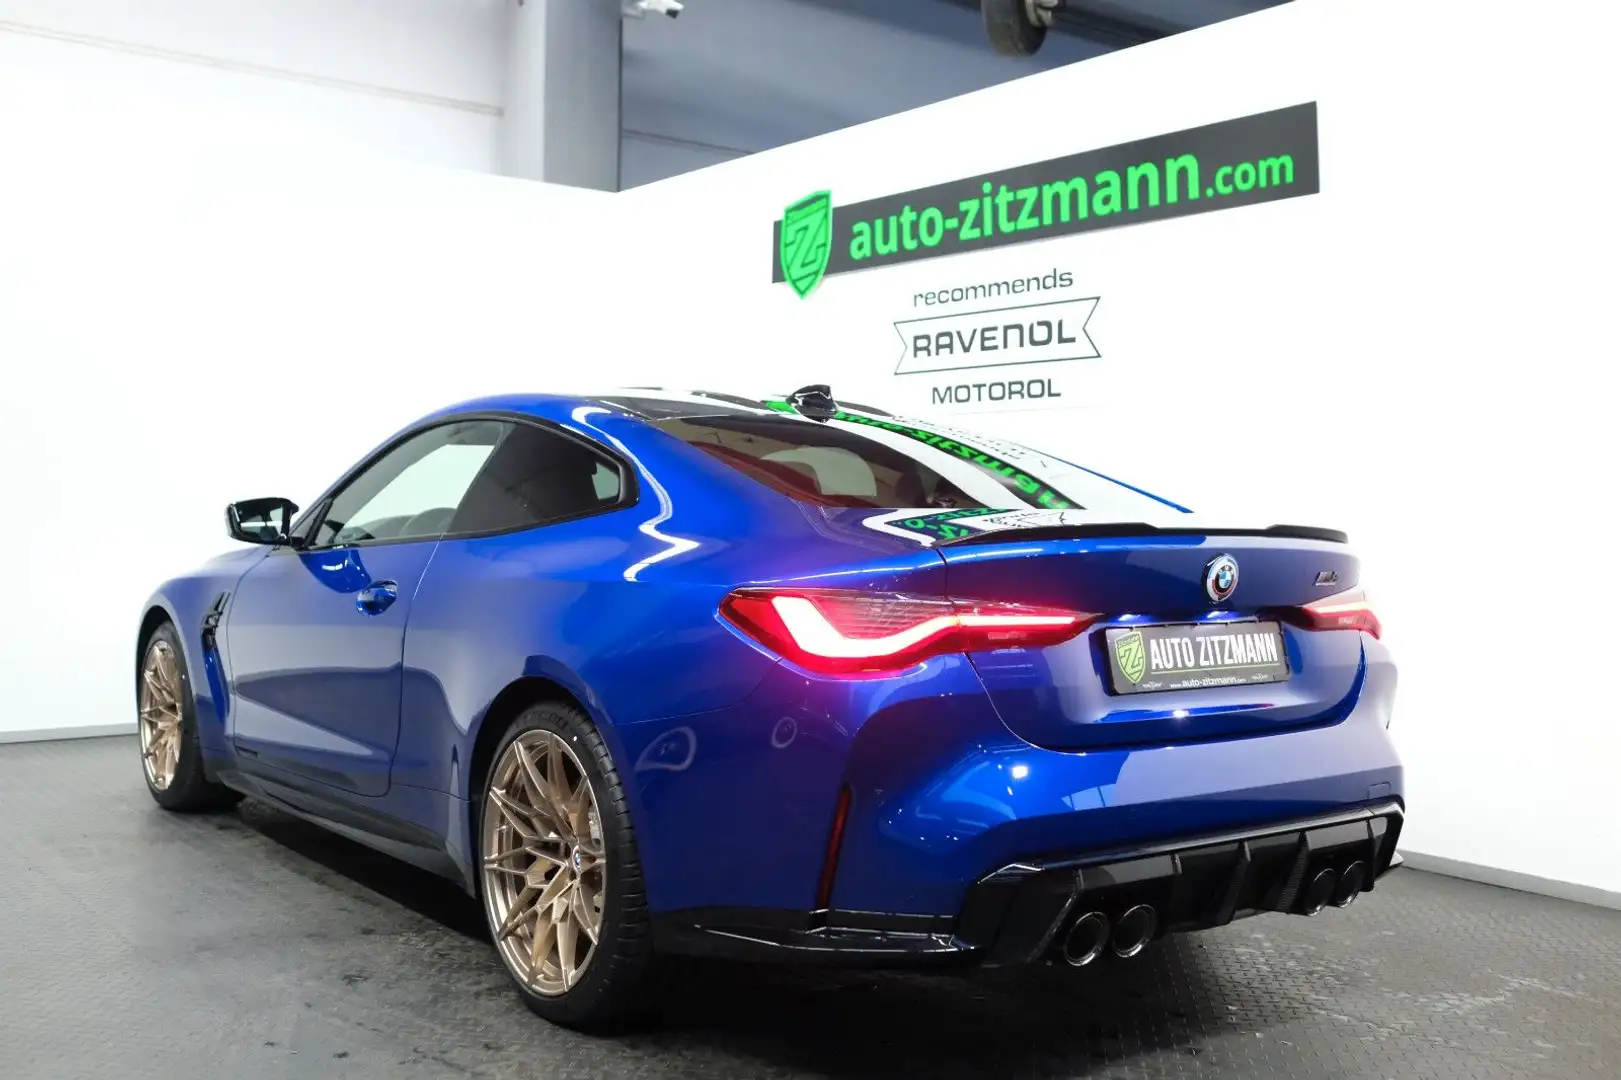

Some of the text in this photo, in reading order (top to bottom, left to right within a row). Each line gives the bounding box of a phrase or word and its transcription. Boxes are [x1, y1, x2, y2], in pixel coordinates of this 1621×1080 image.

[849, 153, 1294, 261] auto-zitzmann.com
[913, 268, 1074, 307] recommends
[912, 319, 1077, 359] RAVENOL
[932, 379, 1062, 404] MOTOROL
[1150, 632, 1278, 670] AUTO ZITZMANN
